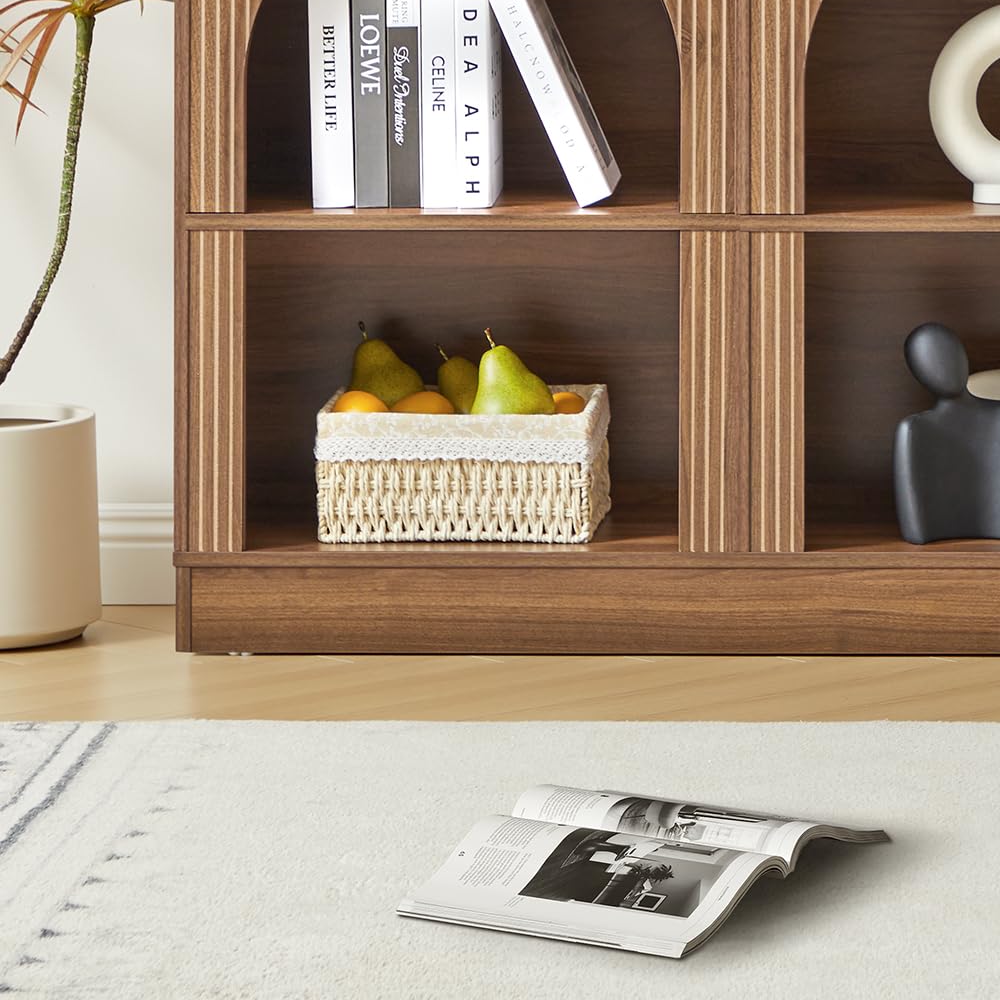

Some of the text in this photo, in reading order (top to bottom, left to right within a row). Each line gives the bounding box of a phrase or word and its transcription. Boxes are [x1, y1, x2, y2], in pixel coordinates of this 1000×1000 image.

[322, 24, 337, 131] BETTER LIFE
[359, 13, 381, 96] LOEWE
[393, 46, 410, 83] Duel
[431, 55, 446, 112] CELINE
